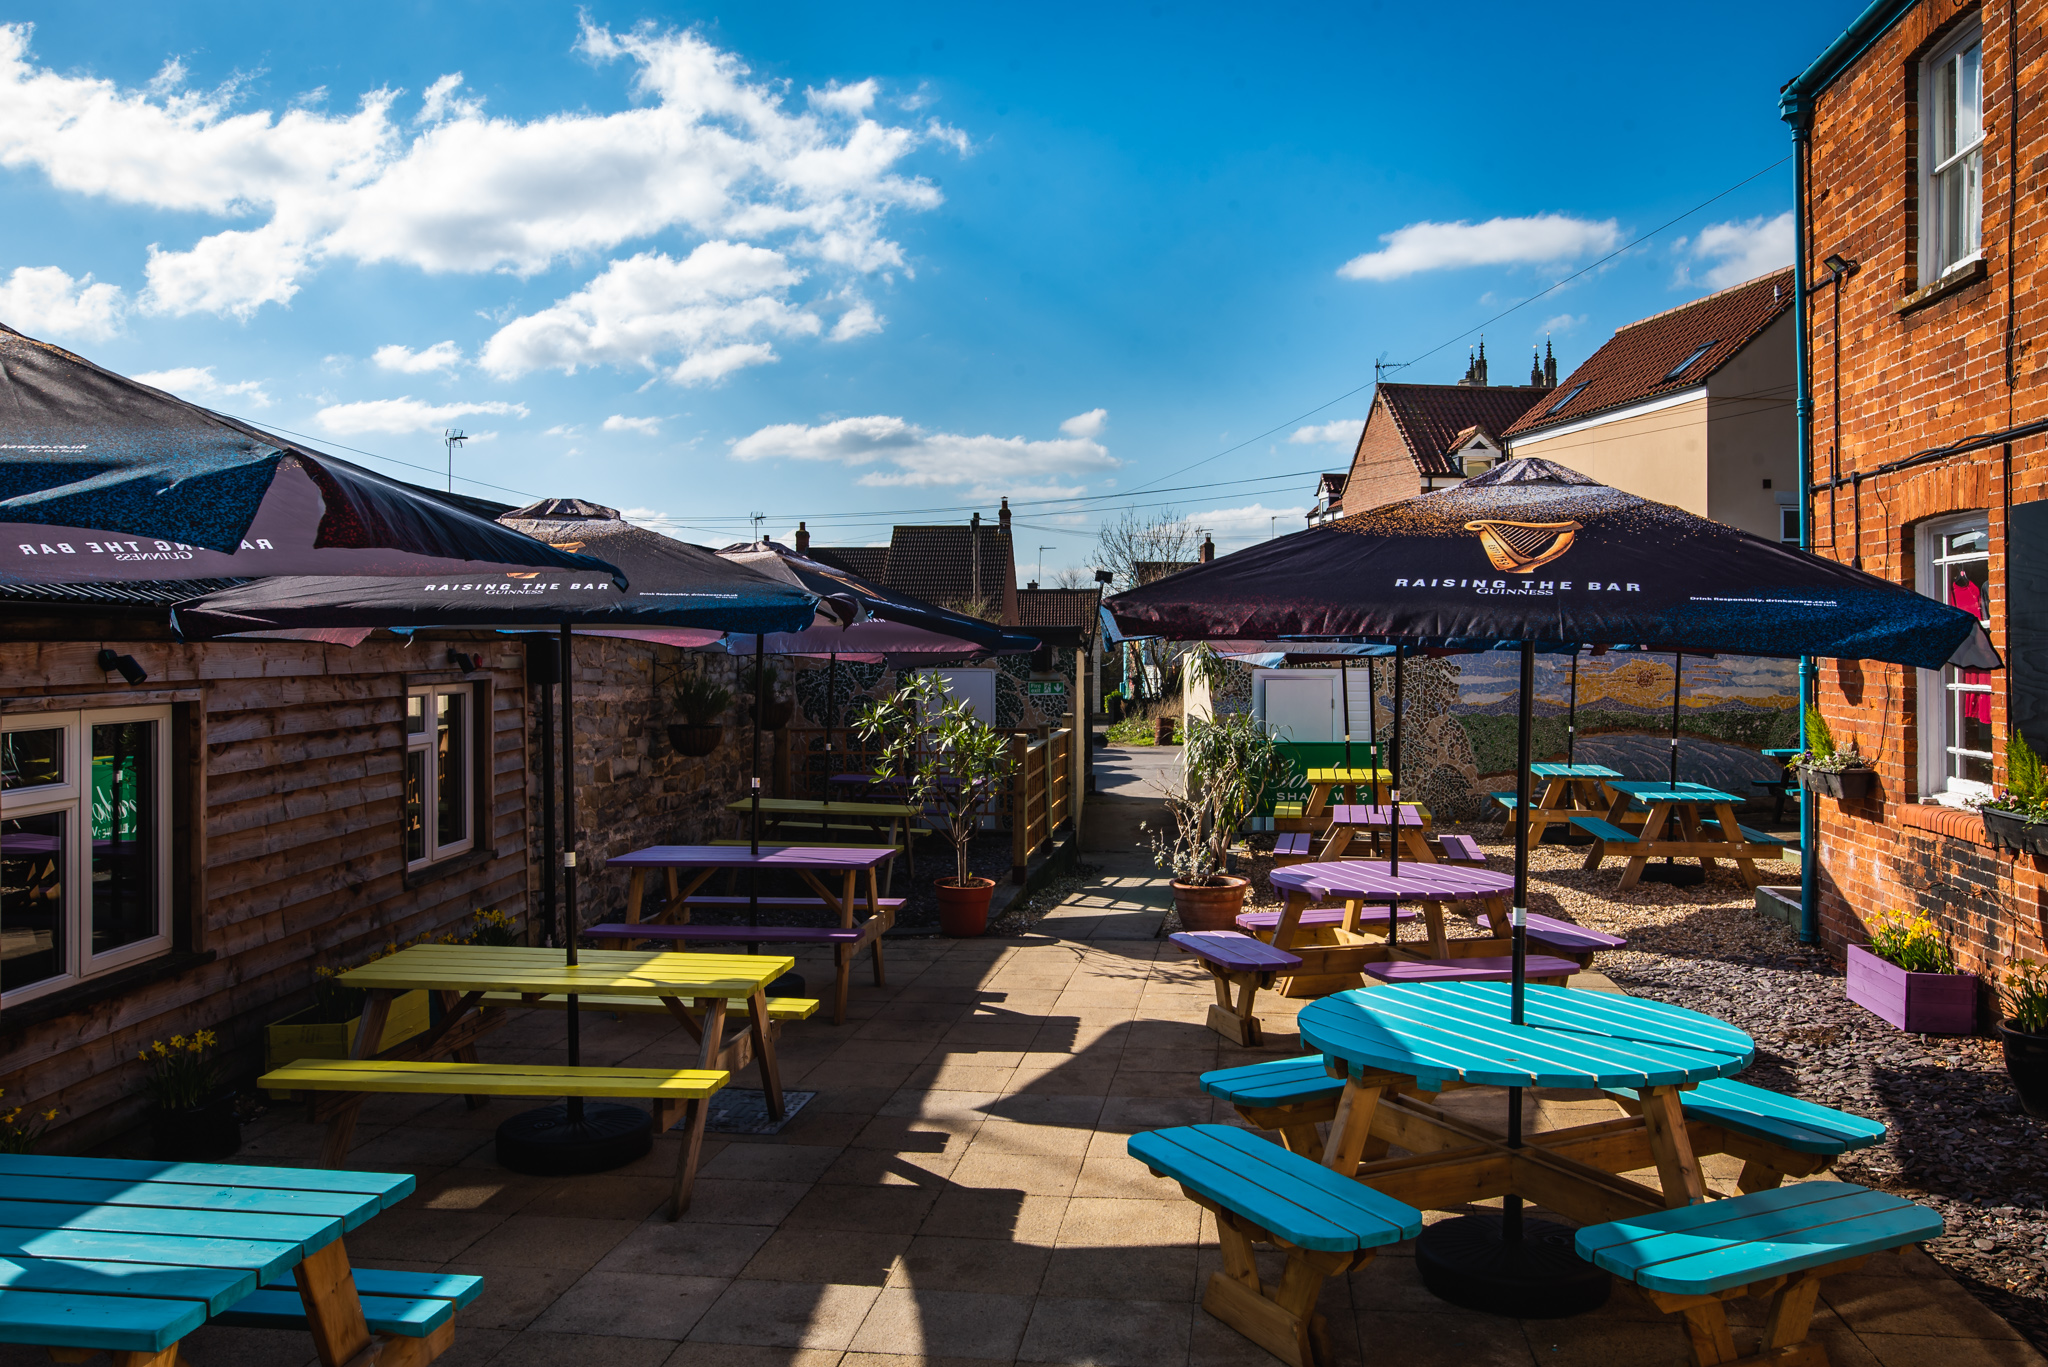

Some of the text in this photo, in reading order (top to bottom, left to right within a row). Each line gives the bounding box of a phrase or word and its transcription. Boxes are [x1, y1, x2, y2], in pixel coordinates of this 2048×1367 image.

[424, 583, 511, 591] RAISING
[1394, 578, 1641, 592] RAISING THE BAR
[1476, 587, 1554, 596] GUINNESS
